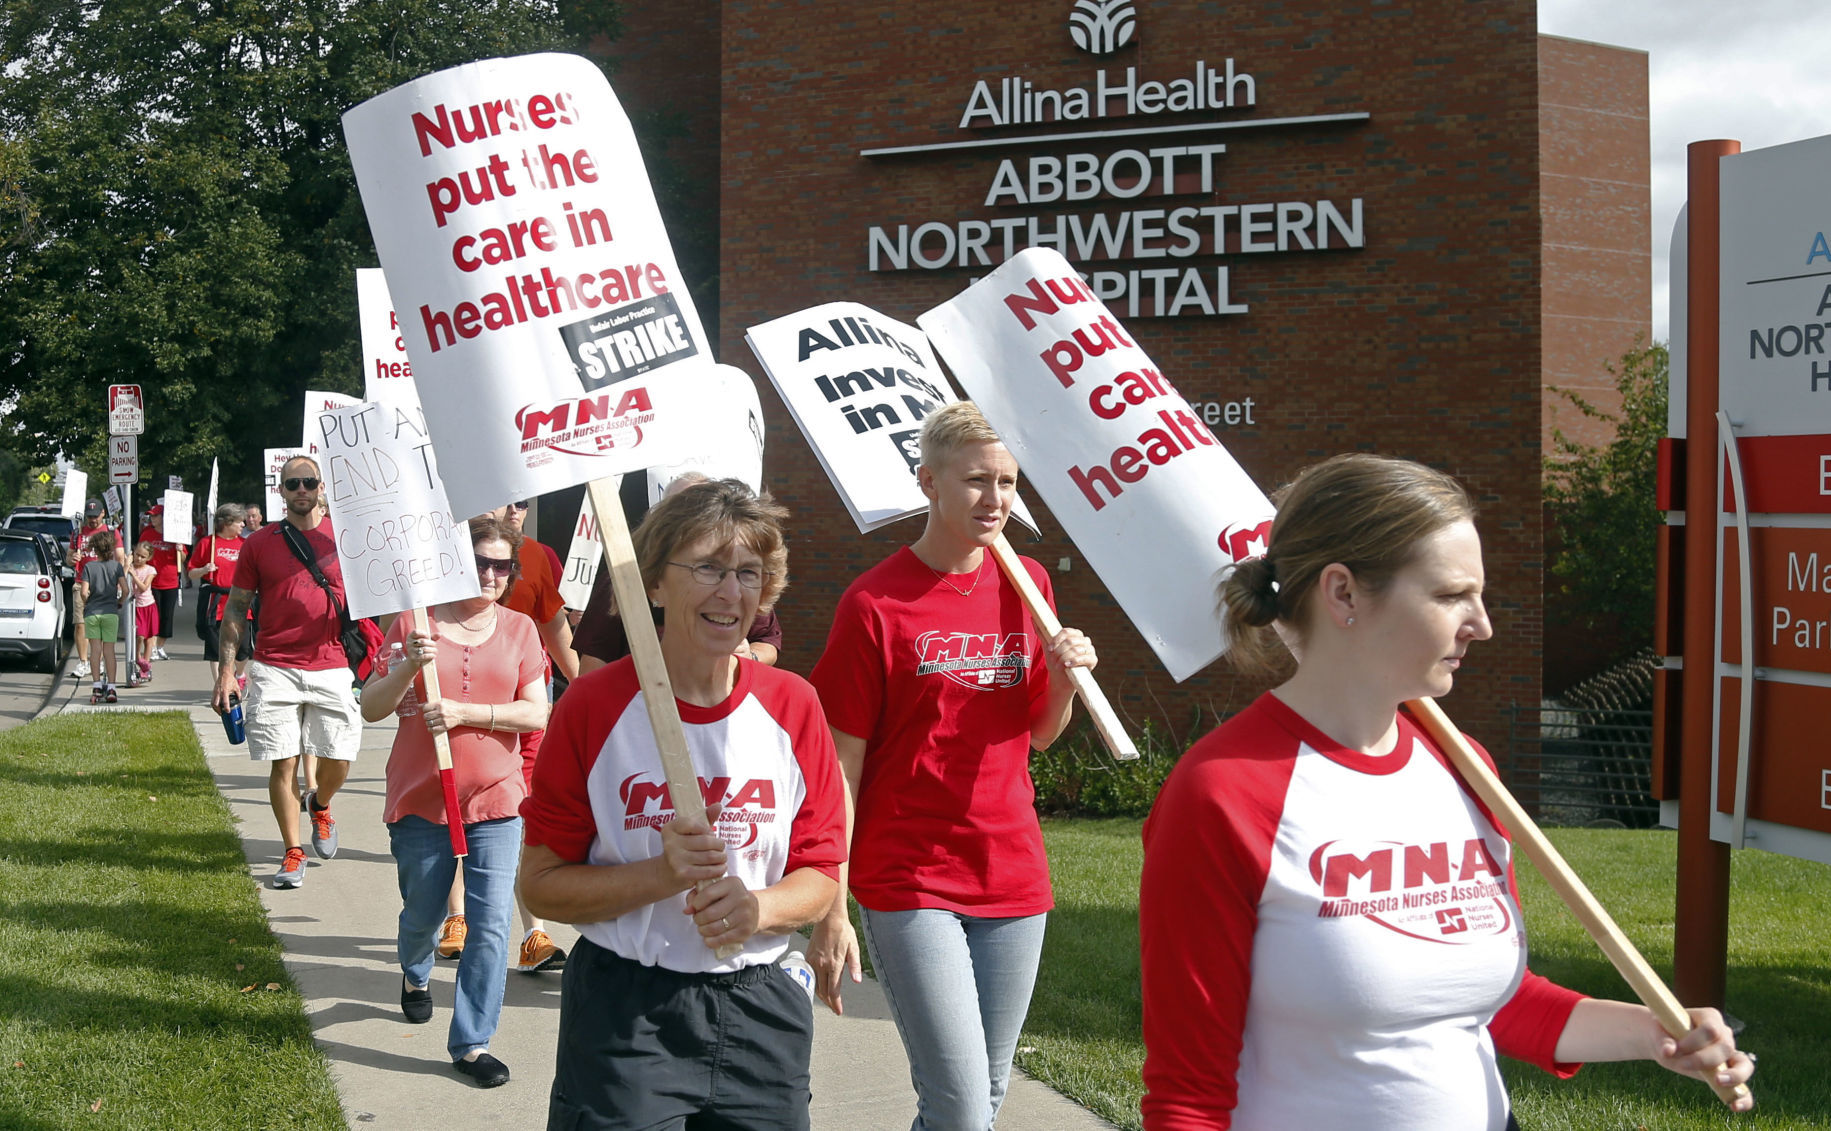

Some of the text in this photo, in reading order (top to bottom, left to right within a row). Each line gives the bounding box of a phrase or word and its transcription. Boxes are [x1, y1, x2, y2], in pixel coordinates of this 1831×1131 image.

[959, 57, 1256, 129] Allina Health
[411, 91, 580, 158] Nurses
[426, 143, 600, 229] put the
[984, 143, 1226, 207] ABBOTT
[452, 201, 614, 273] care in
[868, 198, 1364, 272] NORTHWESTERN
[419, 262, 669, 354] healthcare
[609, 314, 631, 327] Labor
[578, 313, 690, 380] STRIKE
[798, 316, 927, 363] Allina
[1040, 315, 1134, 390] put
[522, 387, 653, 441] MNA
[1089, 368, 1184, 420] car
[1191, 397, 1256, 426] reet
[118, 420, 135, 428] ROUTE
[319, 407, 375, 449] PUT
[520, 431, 572, 454] Minnesota
[573, 422, 604, 439] Nurses
[606, 413, 655, 431] Association
[840, 404, 902, 435] in
[112, 456, 135, 467] PARKING
[117, 440, 129, 453] NO
[1067, 408, 1221, 512] healt
[330, 447, 400, 502] END
[367, 545, 464, 597] GREED!
[917, 660, 962, 676] Minnesota
[961, 659, 991, 669] Nurses
[921, 633, 1031, 663] MNA
[624, 809, 776, 831] Minnesot ssociation
[720, 825, 748, 833] National
[1323, 838, 1504, 898] MNA
[1318, 898, 1399, 918] Minnesota
[1402, 889, 1447, 910] Nurses
[1471, 921, 1499, 931] United
